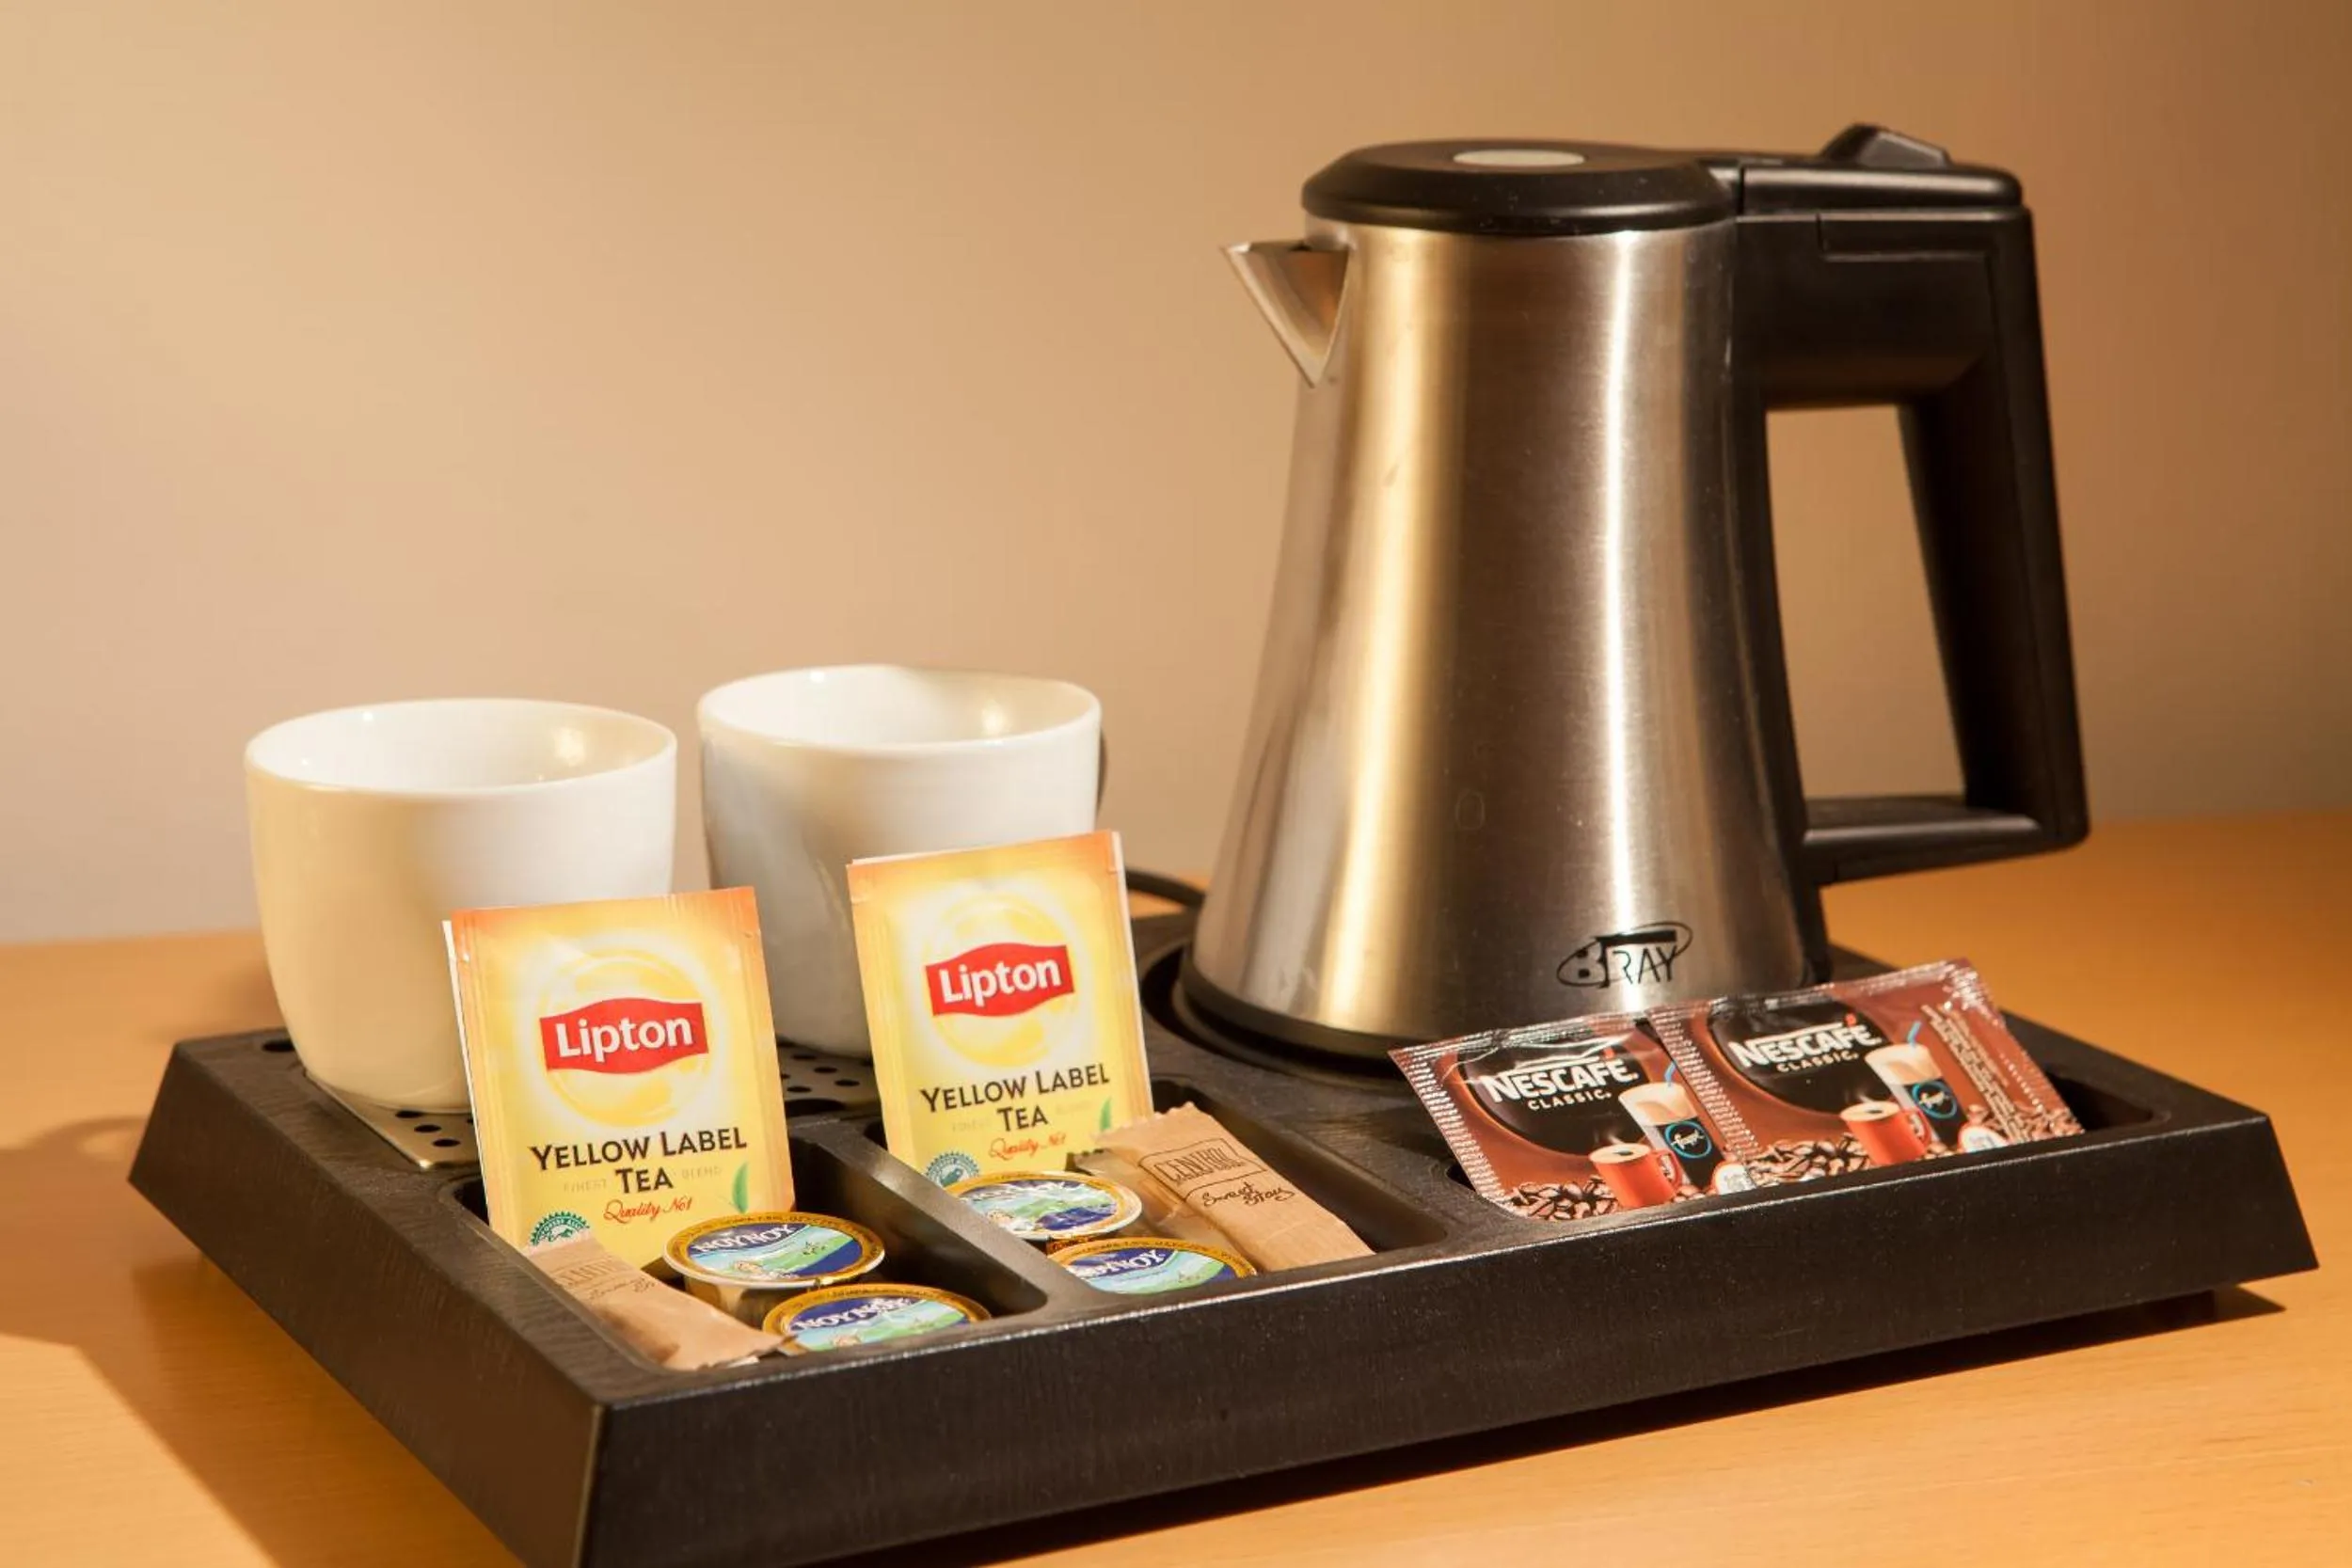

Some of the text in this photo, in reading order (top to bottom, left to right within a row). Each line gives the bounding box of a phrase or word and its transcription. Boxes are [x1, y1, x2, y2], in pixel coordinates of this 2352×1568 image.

[939, 958, 1061, 1006] Lipton
[554, 1015, 693, 1063] Lipton
[1776, 1051, 1852, 1073] CLASSIC
[918, 1063, 1110, 1113] YELLOW LABEL
[1528, 1090, 1604, 1111] CLASSIC
[997, 1105, 1048, 1132] TEA
[529, 1127, 747, 1171] YELLOW LABEL
[615, 1167, 674, 1194] TEA
[603, 1198, 660, 1223] Quality
